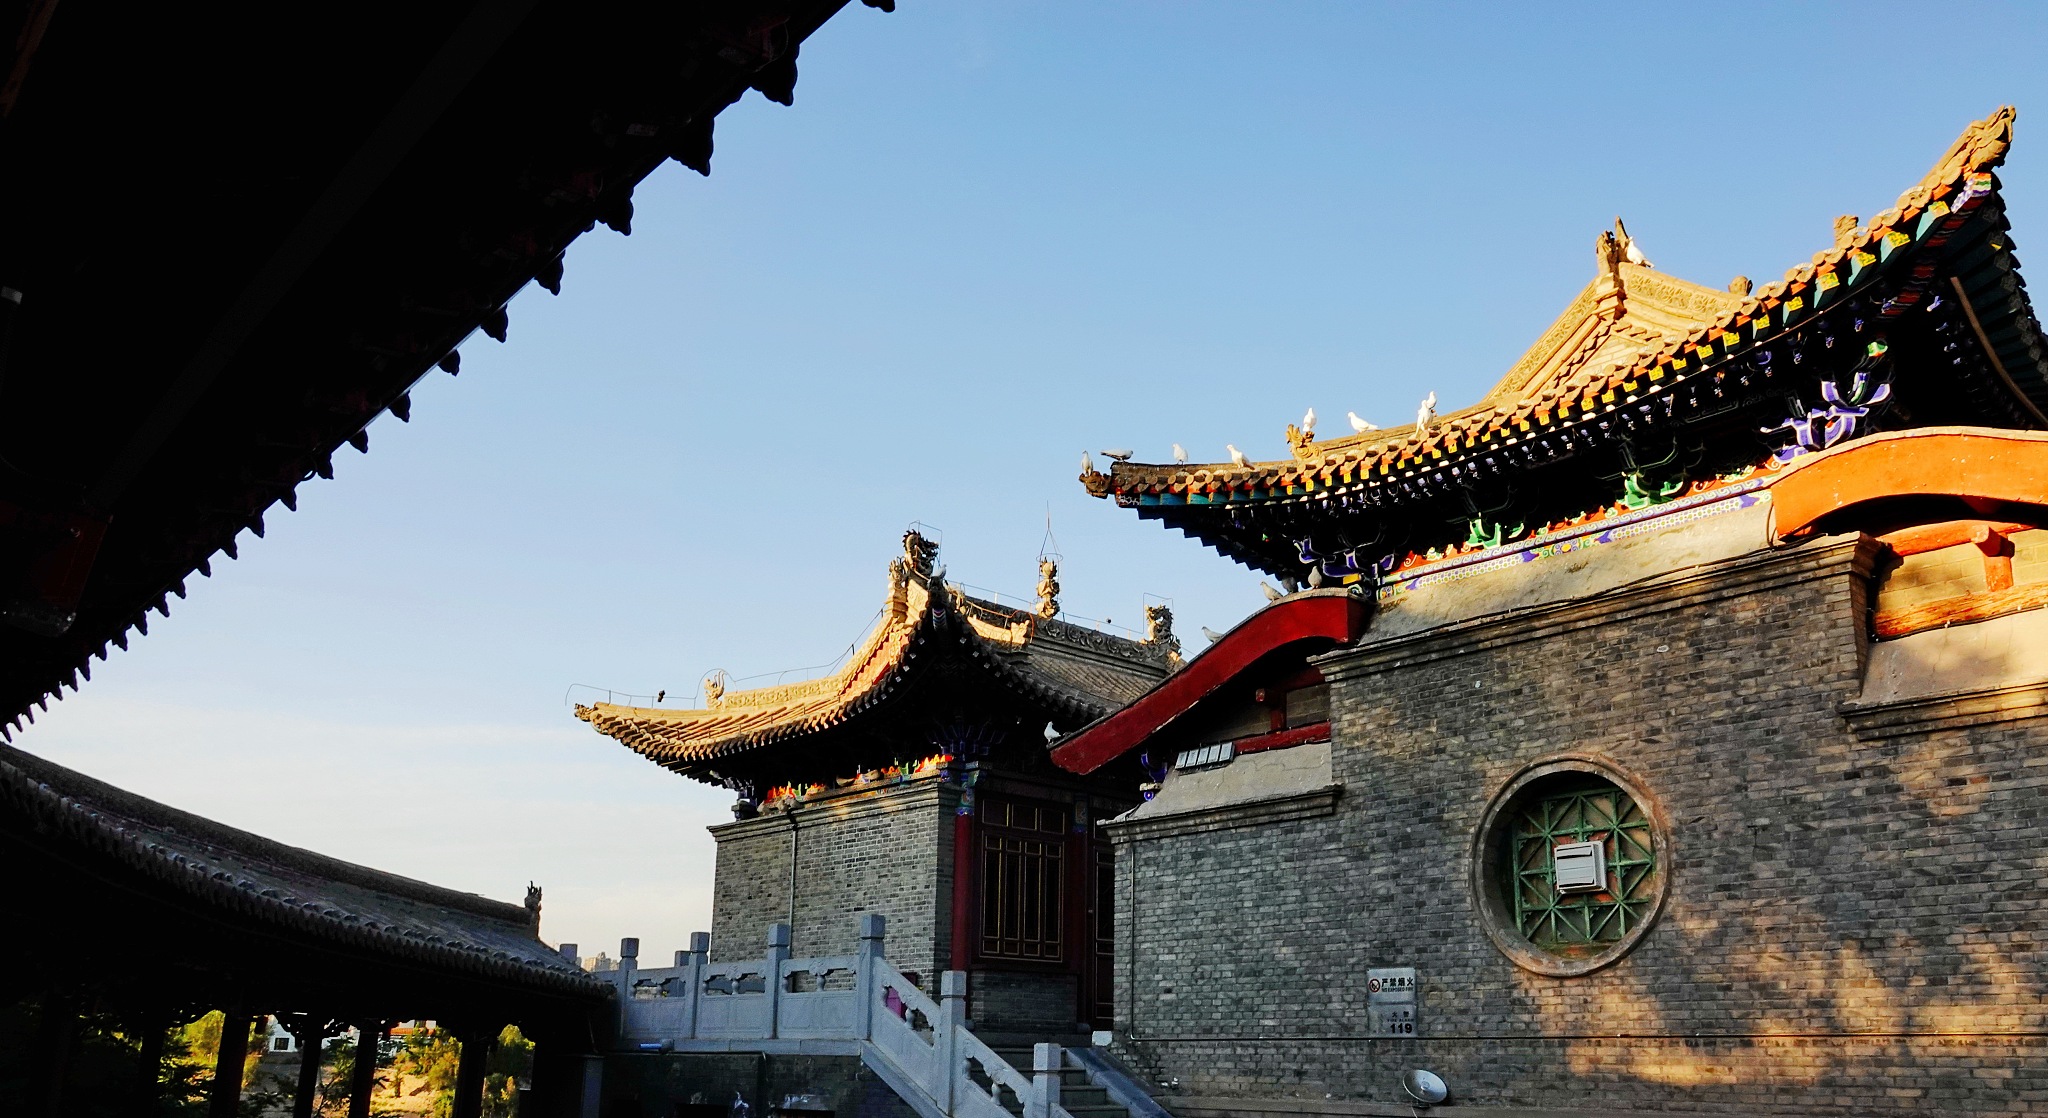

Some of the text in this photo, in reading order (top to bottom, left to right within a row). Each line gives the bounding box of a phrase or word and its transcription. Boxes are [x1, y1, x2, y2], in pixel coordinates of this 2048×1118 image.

[1381, 977, 1414, 987] 严禁烟火
[1390, 1023, 1412, 1034] 119
